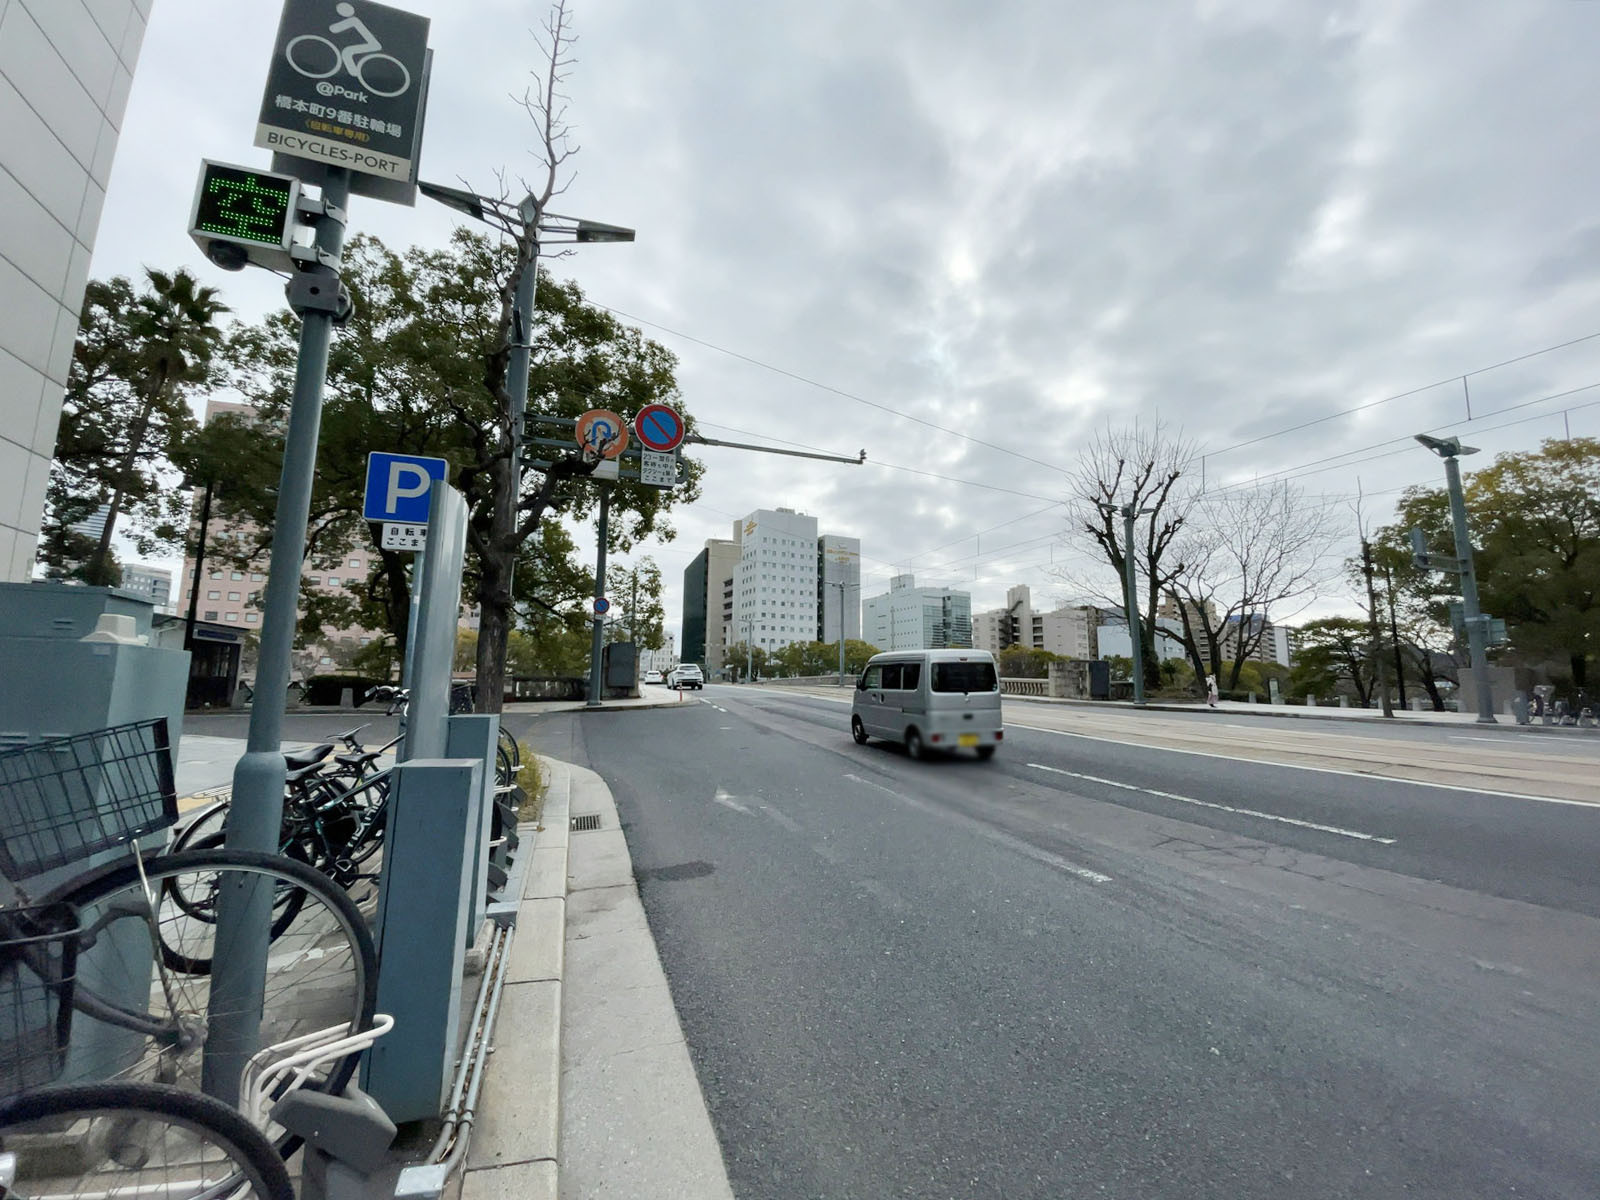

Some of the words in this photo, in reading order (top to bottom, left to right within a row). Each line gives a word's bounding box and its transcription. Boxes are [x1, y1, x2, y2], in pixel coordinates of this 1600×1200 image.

[315, 81, 369, 104] @Park
[275, 94, 402, 138] 橋本町9番駐輪場
[267, 131, 400, 174] BICYCLES-PORT
[202, 177, 288, 244] 空
[385, 461, 431, 514] P
[387, 537, 426, 547] ここま
